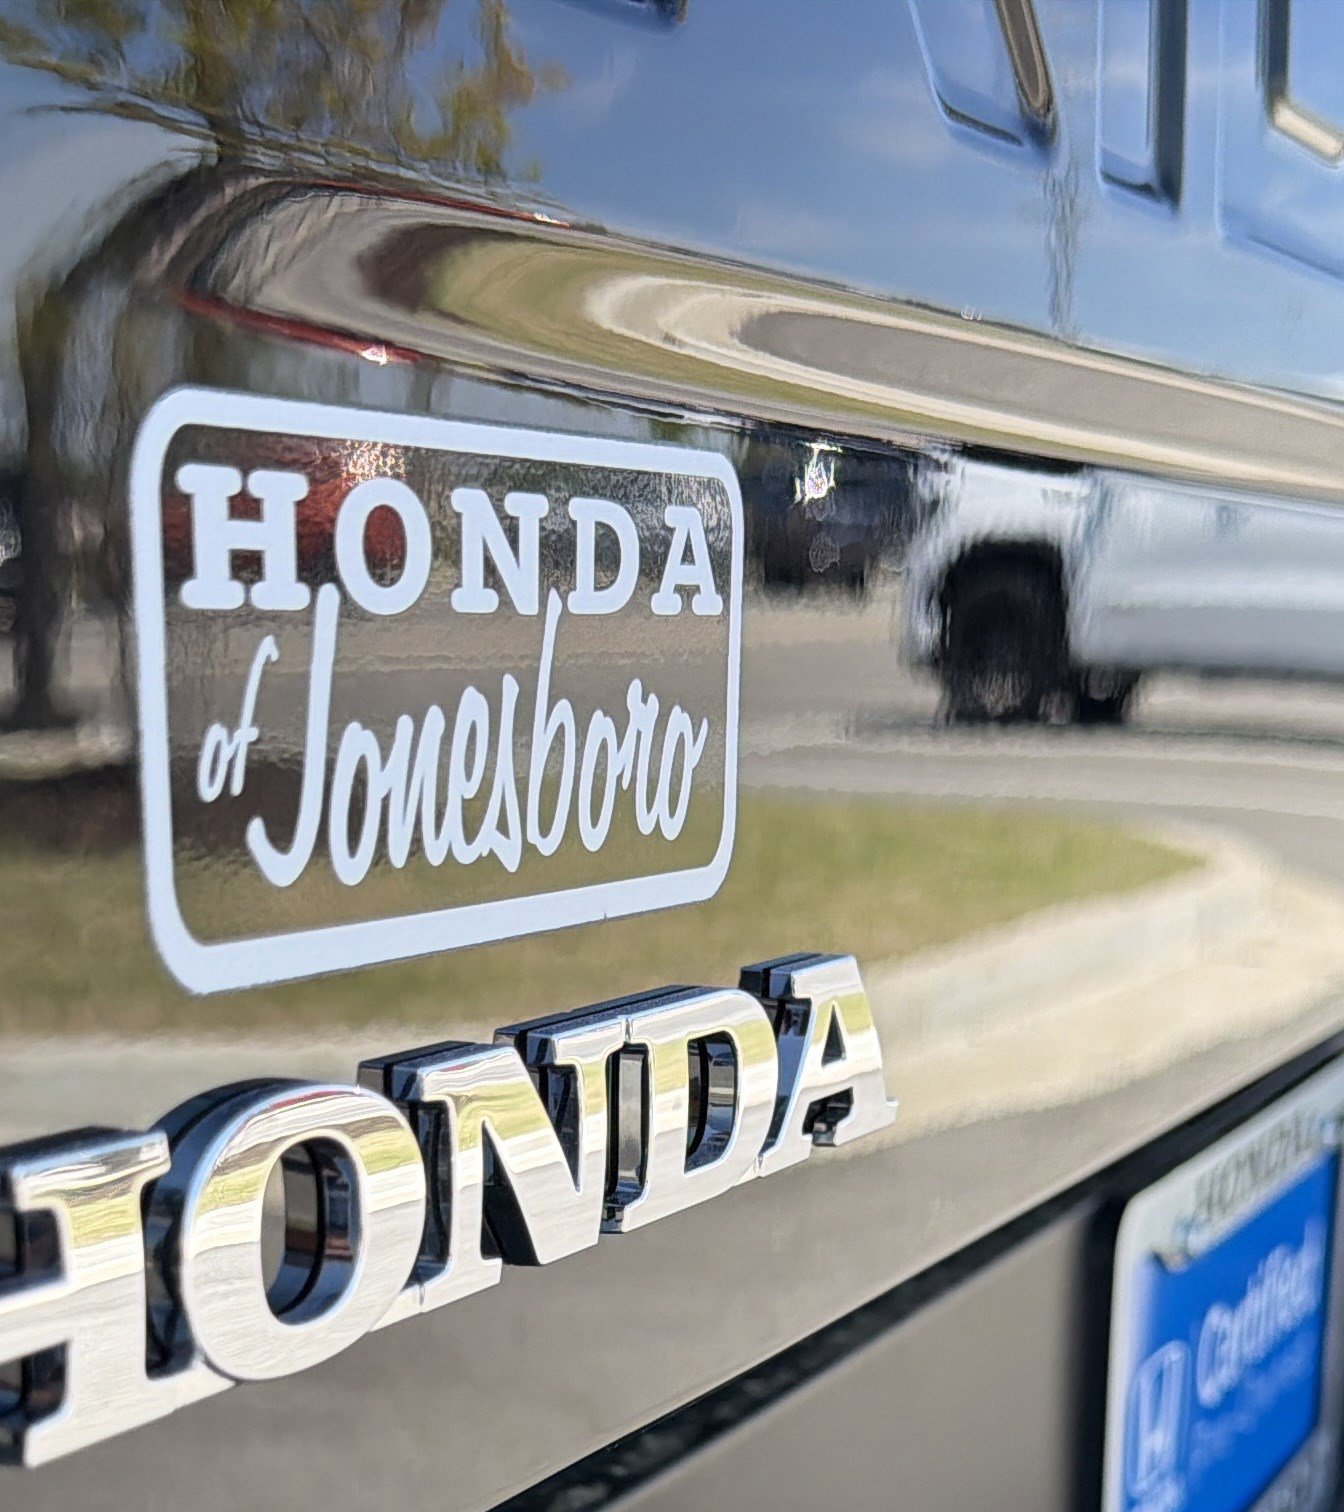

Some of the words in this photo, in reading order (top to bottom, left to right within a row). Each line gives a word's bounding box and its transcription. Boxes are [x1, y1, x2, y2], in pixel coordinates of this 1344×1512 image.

[173, 462, 724, 617] HONDA
[197, 634, 279, 803] of
[246, 582, 709, 888] Jonesboro
